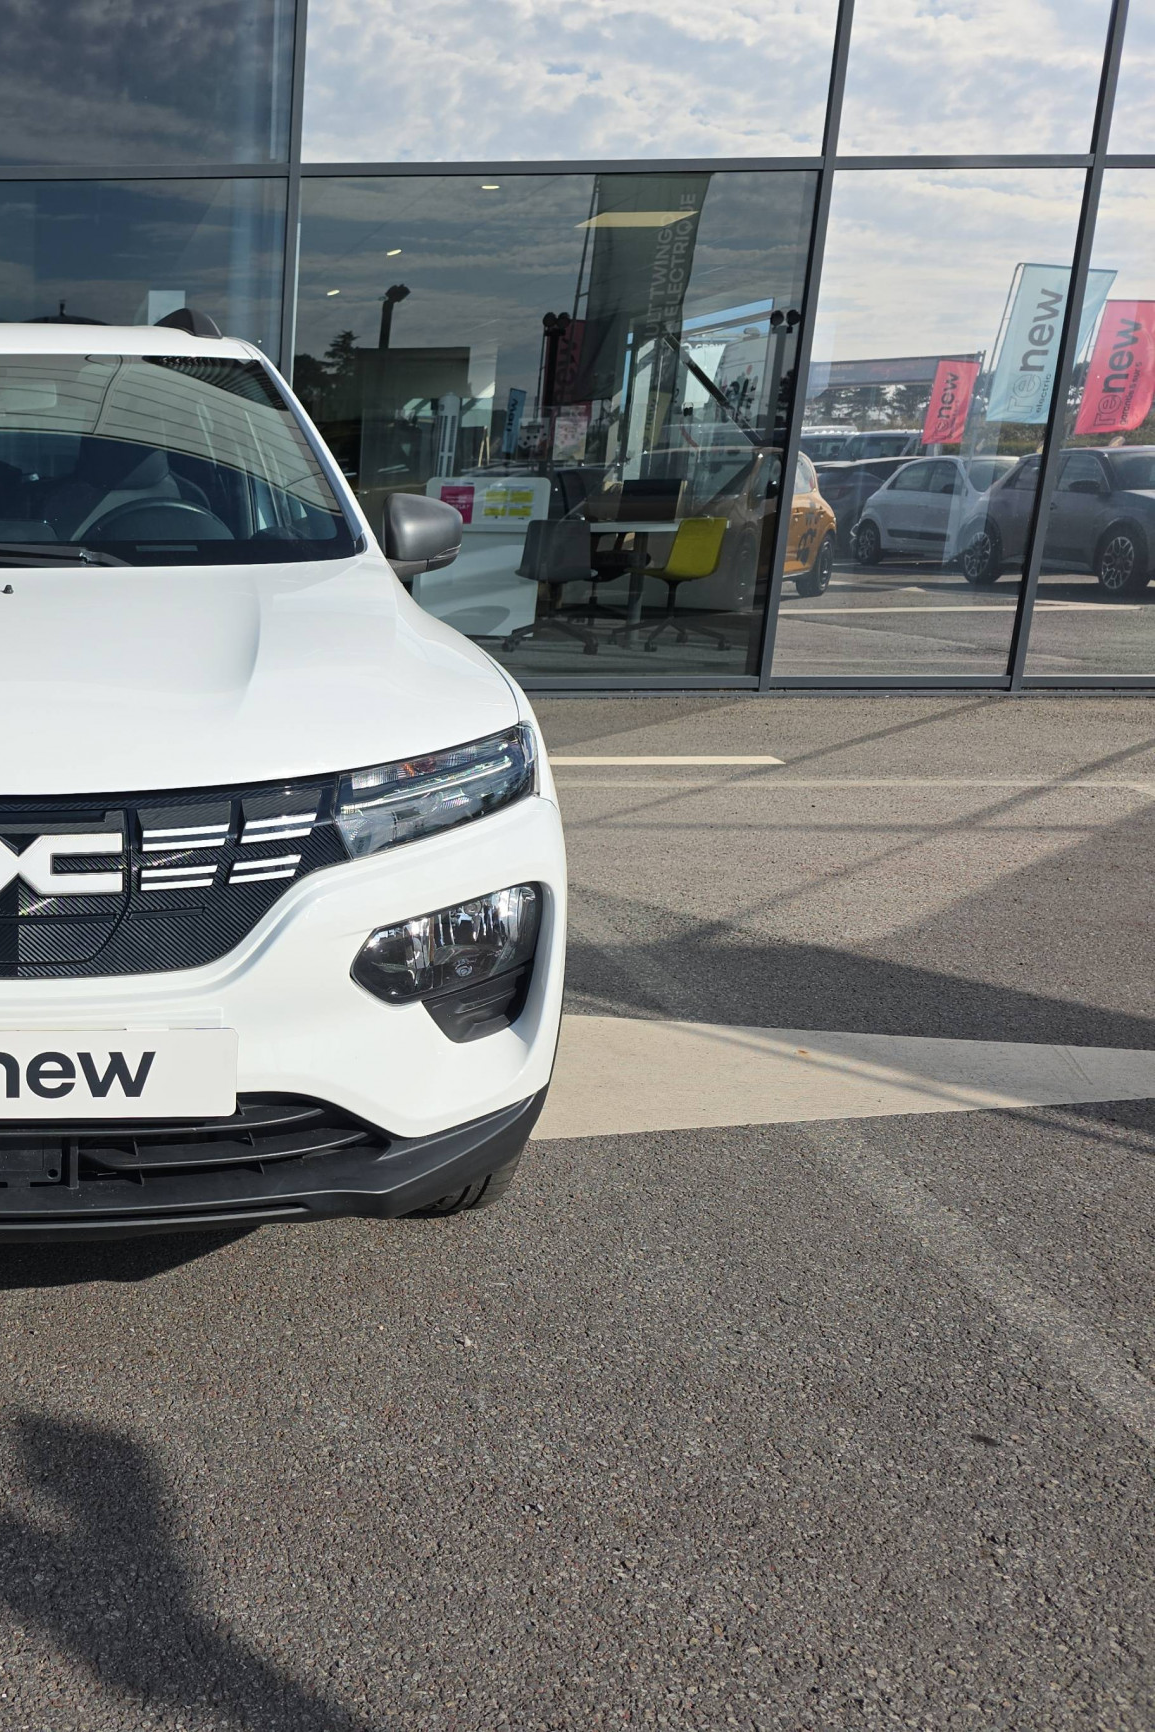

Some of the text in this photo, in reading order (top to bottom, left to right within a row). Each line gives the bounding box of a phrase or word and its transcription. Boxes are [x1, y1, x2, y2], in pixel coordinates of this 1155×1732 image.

[1007, 288, 1064, 414] renew
[1035, 373, 1052, 413] electric
[1093, 318, 1143, 427] renew
